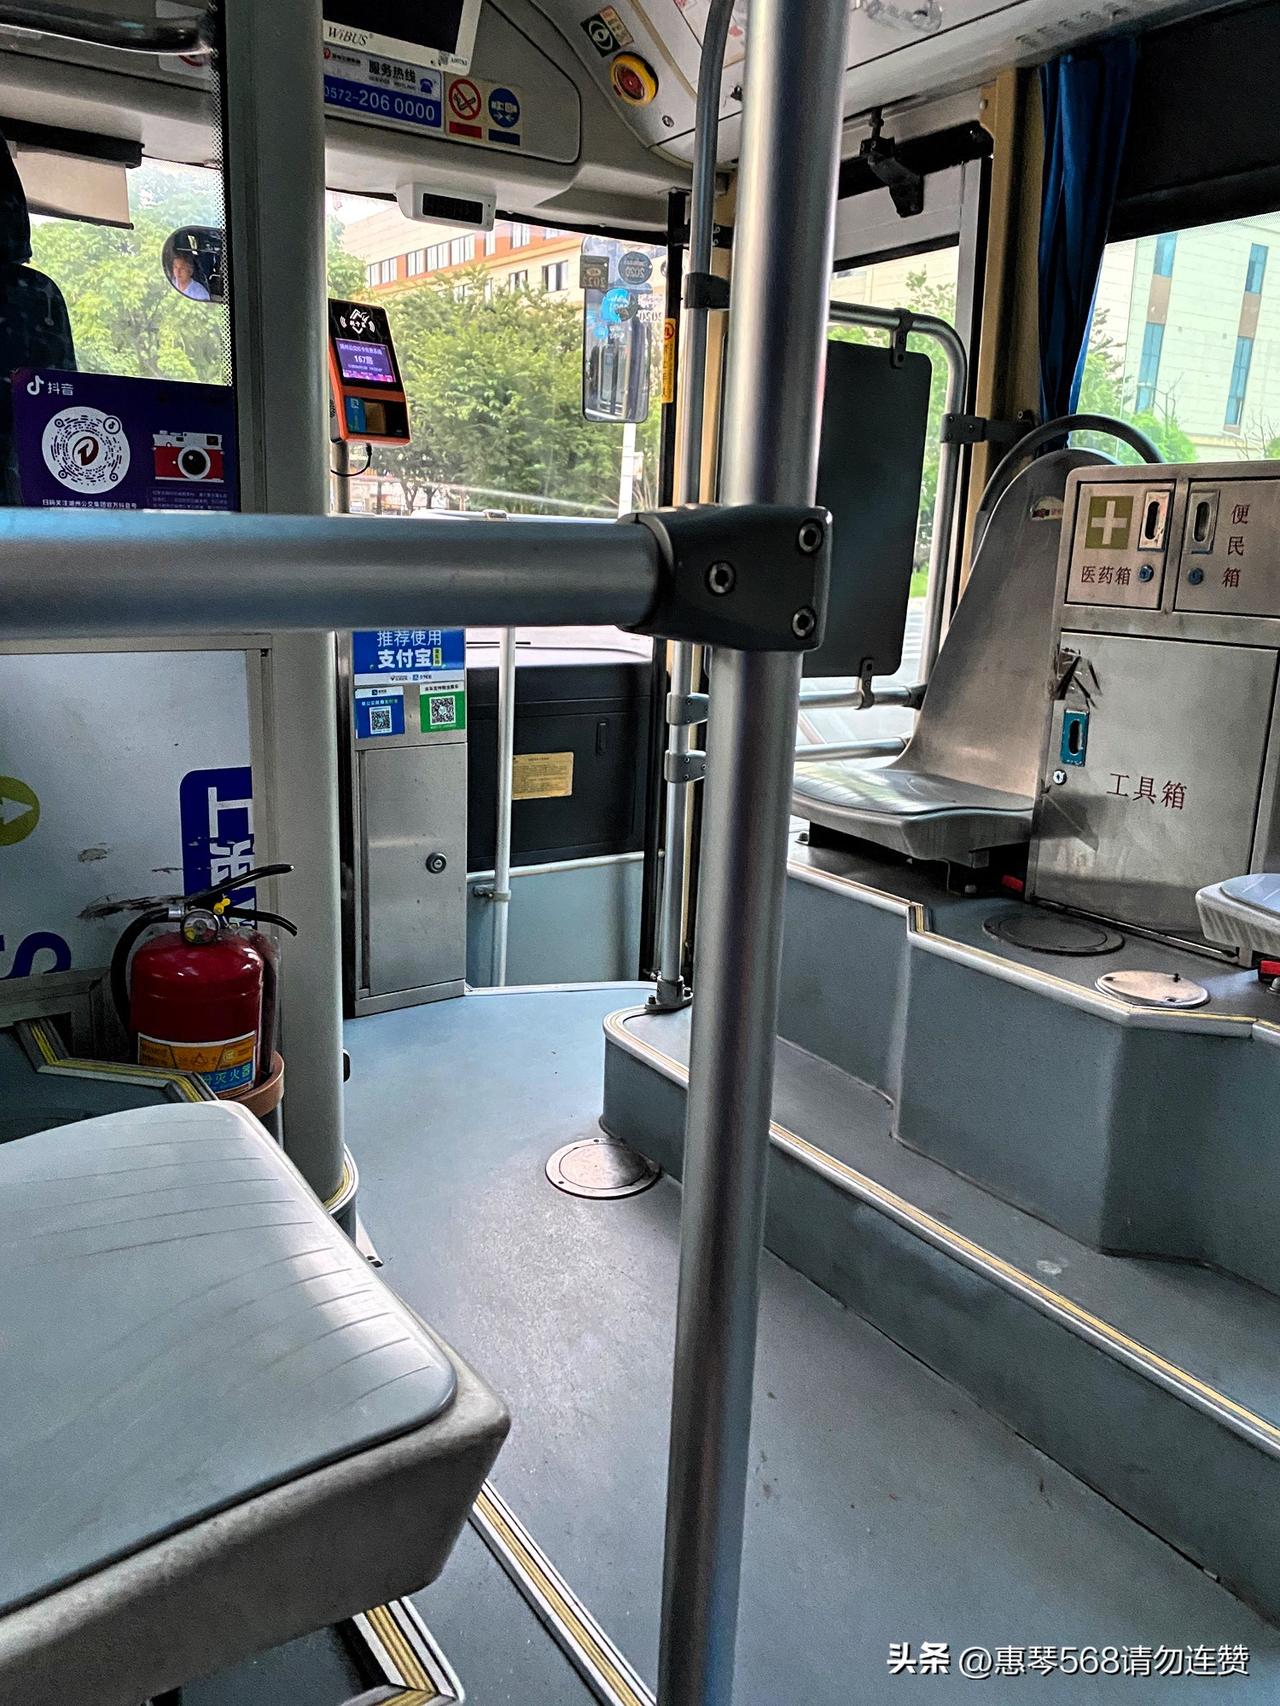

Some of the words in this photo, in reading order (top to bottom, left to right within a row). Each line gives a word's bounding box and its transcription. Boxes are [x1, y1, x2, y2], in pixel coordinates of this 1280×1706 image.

[368, 59, 417, 83] 服务热线
[47, 382, 75, 396] 抖音
[1222, 503, 1250, 588] 便民箱
[1080, 565, 1132, 586] 医药箱
[376, 629, 442, 647] 推荐使用
[377, 648, 431, 668] 支付宝
[1105, 773, 1188, 810] 工具箱
